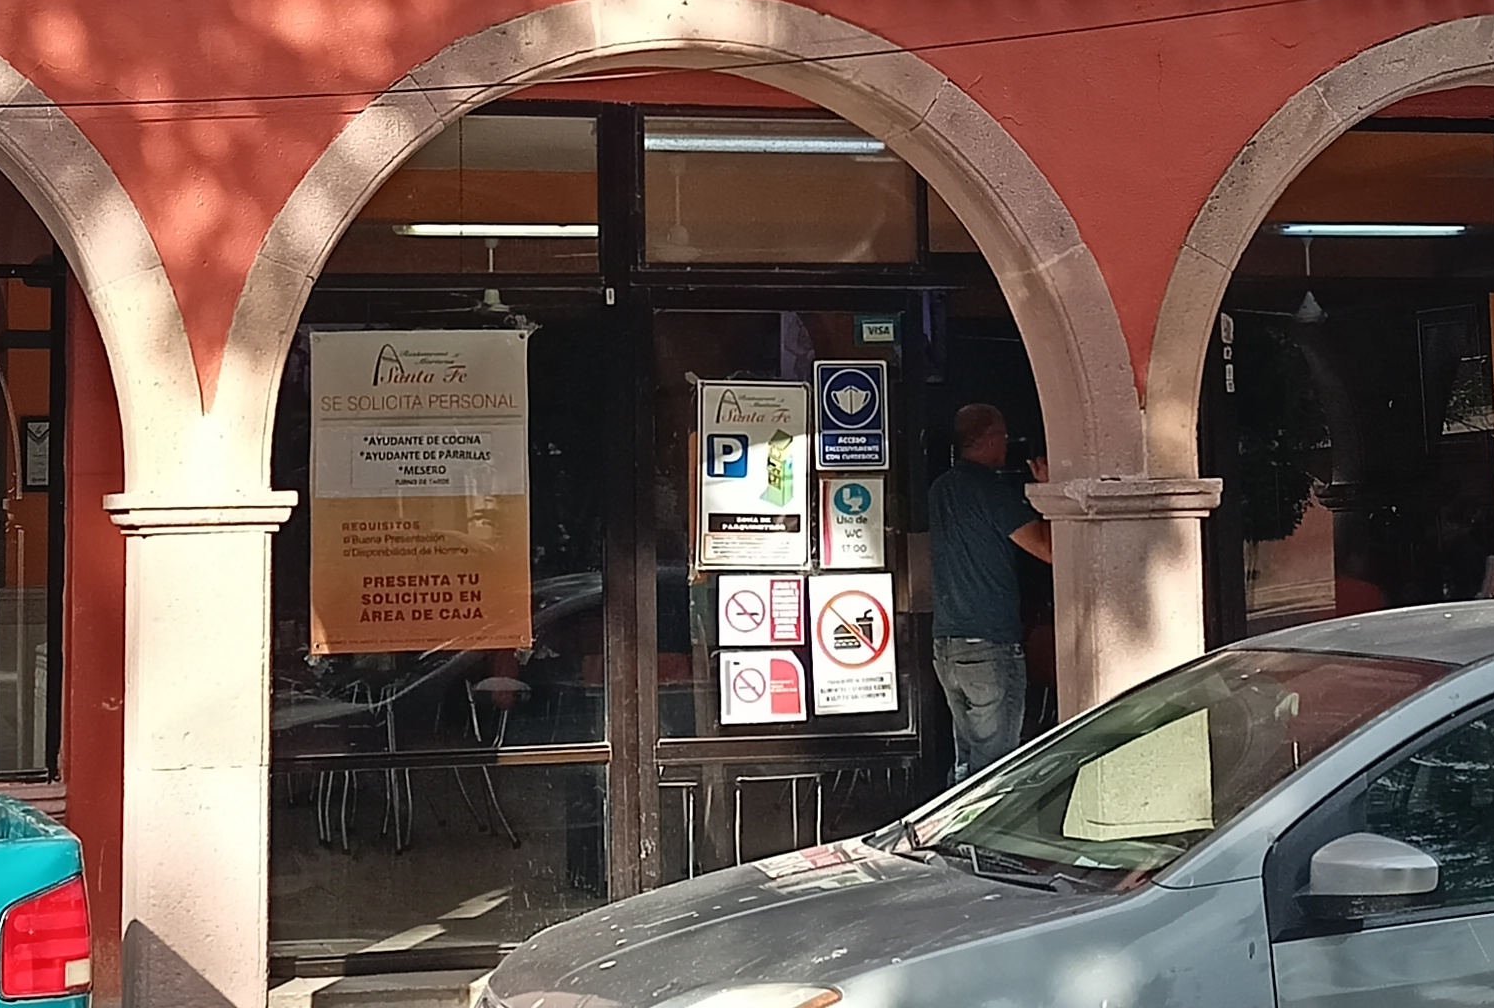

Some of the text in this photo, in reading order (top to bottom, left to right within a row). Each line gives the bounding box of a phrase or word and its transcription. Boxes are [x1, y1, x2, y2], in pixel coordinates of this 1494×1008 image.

[867, 325, 891, 335] VISA
[380, 364, 468, 384] Santa Fe
[320, 393, 518, 412] SE SOLICITA PERSONAL
[426, 435, 441, 446] DE
[441, 434, 482, 445] COCINA
[837, 436, 867, 445] ACCESO
[422, 450, 437, 461] DE
[438, 449, 492, 461] PARRILLAS
[712, 436, 744, 476] P
[825, 453, 841, 461] CON
[341, 520, 421, 531] REQUISITOS
[836, 515, 868, 525] Uso de
[844, 528, 863, 539] WC
[352, 534, 382, 545] Buena
[419, 546, 432, 556] de
[362, 573, 480, 589] PRESENTA TU
[459, 590, 482, 603] EN
[360, 607, 484, 623] ÁREA DE CAJA
